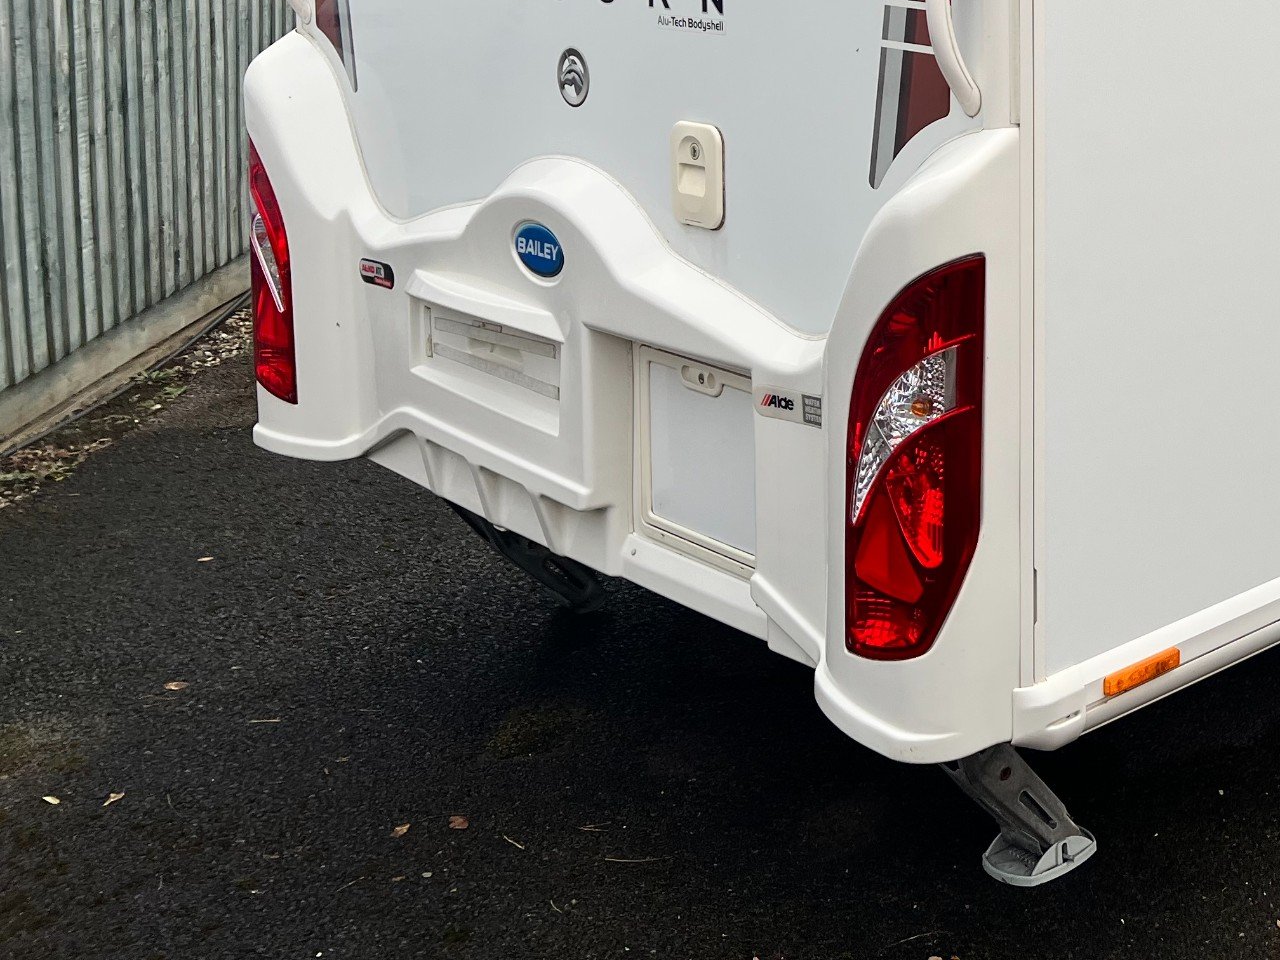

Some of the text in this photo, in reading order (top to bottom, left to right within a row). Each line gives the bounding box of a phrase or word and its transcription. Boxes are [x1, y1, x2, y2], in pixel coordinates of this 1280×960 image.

[657, 15, 724, 32] Alu-Tech Bodyshell
[517, 236, 559, 261] BAILEY
[768, 394, 795, 411] Alde
